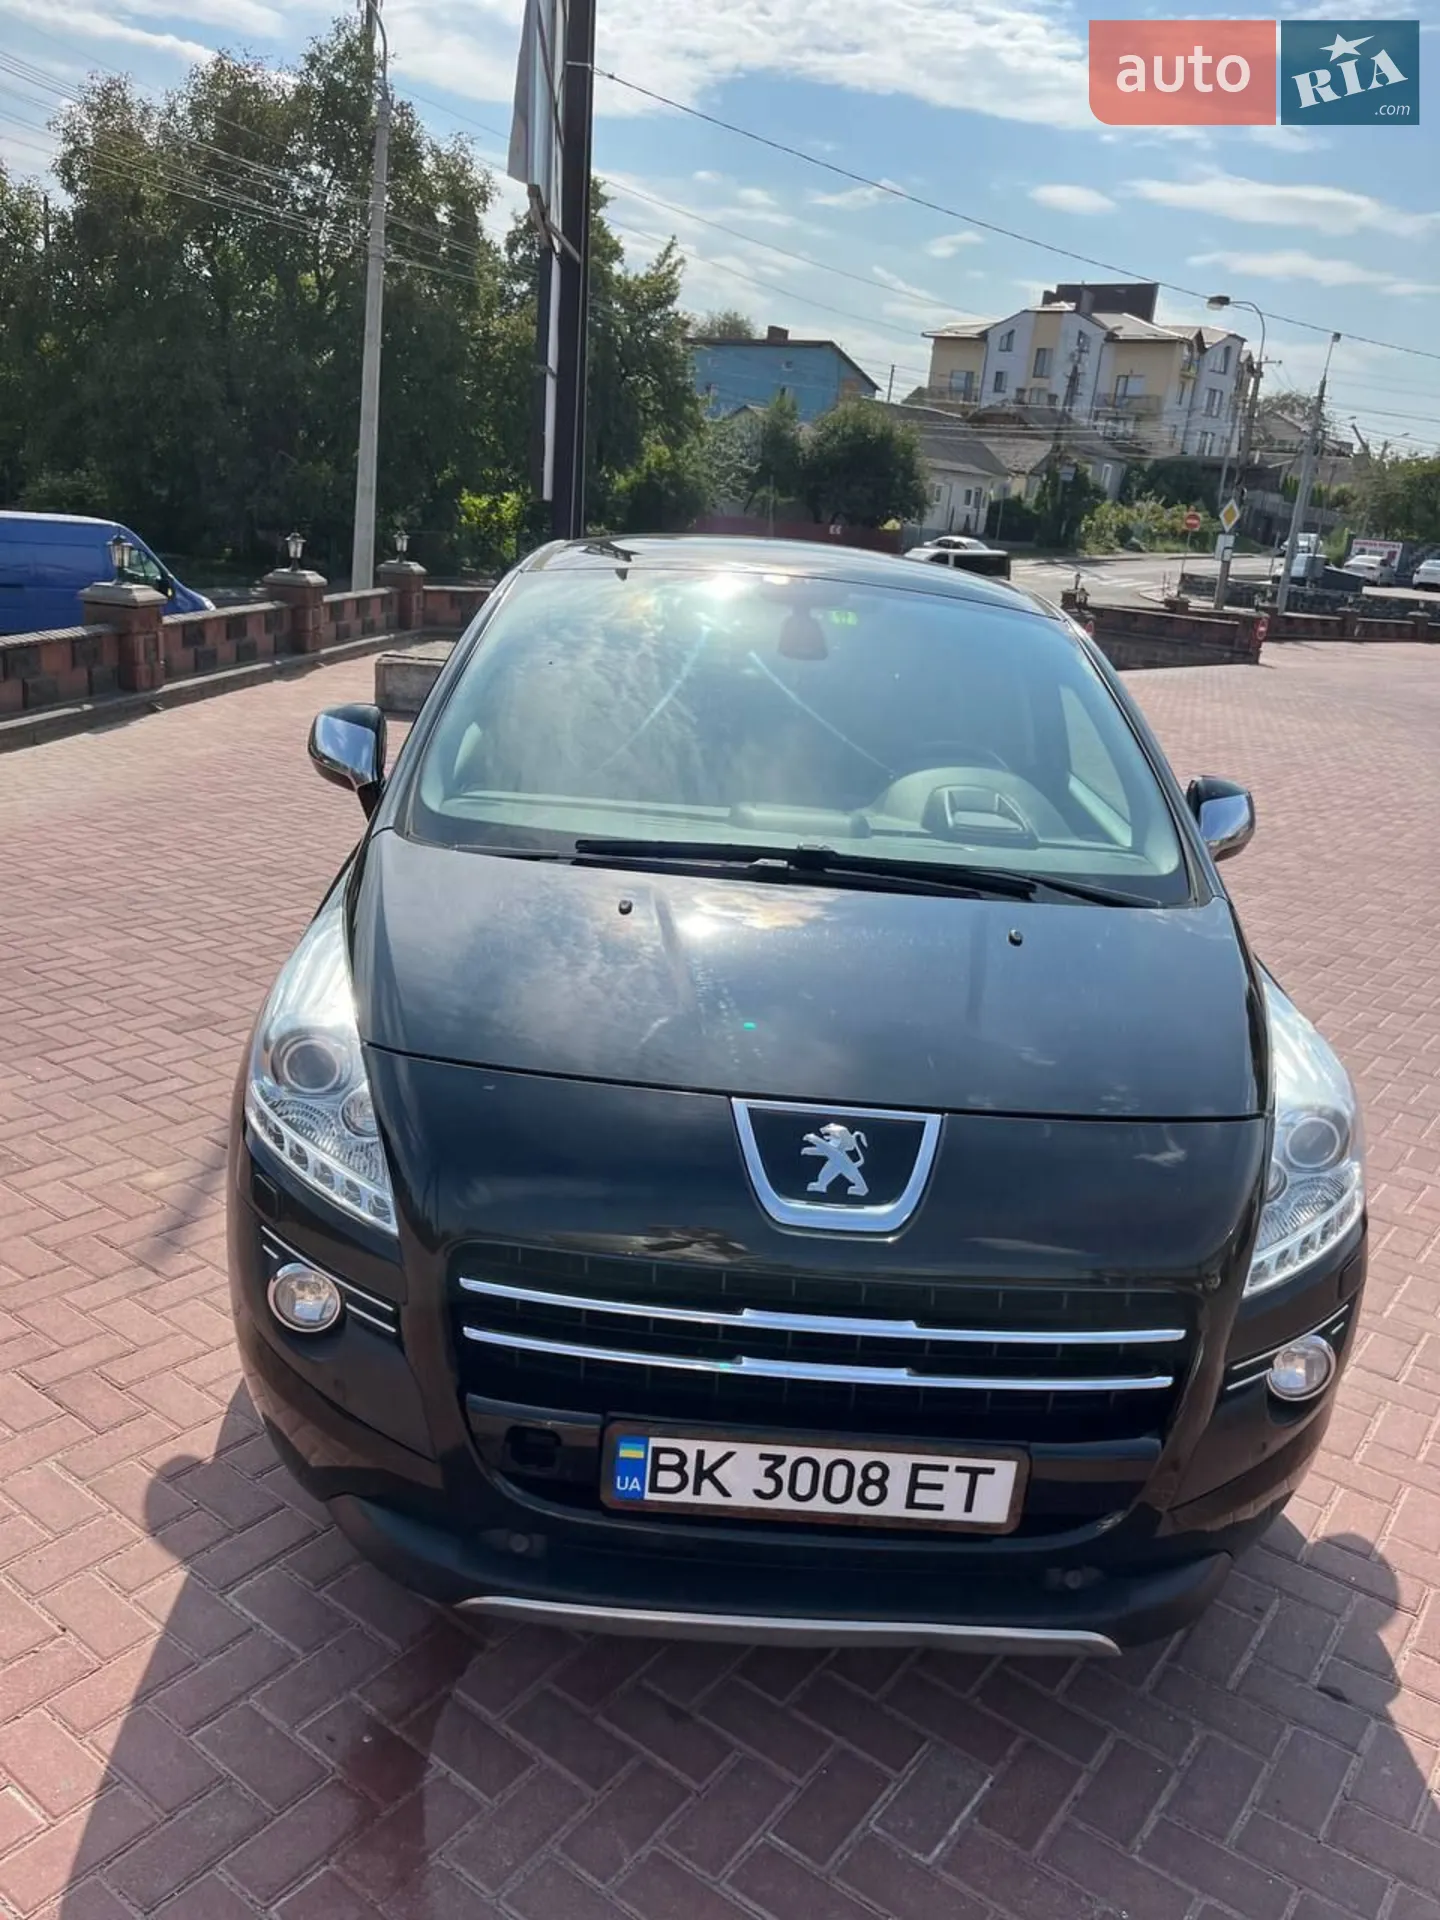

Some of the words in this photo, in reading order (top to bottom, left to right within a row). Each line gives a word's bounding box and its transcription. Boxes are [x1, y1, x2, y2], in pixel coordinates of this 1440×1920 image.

[616, 1476, 641, 1491] UA
[648, 1446, 737, 1498] BK
[752, 1453, 891, 1507] 3008
[905, 1462, 996, 1513] ET
